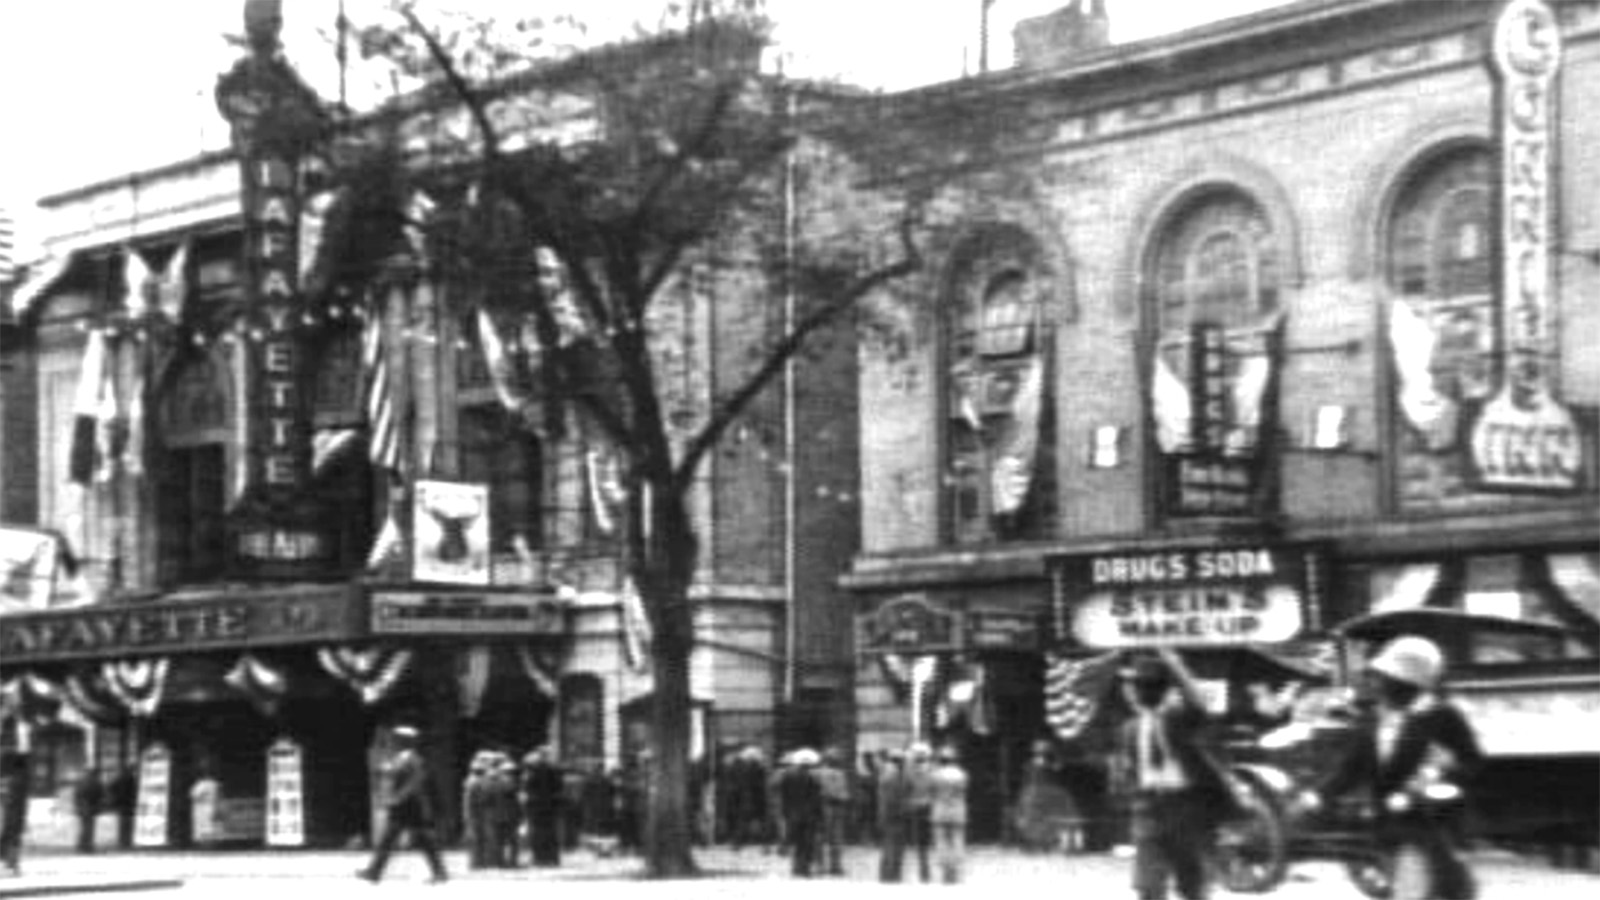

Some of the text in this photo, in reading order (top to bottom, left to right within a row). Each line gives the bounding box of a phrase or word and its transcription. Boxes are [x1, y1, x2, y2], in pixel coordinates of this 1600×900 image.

[1486, 422, 1575, 478] INN
[1092, 548, 1275, 583] DRUGS SODA
